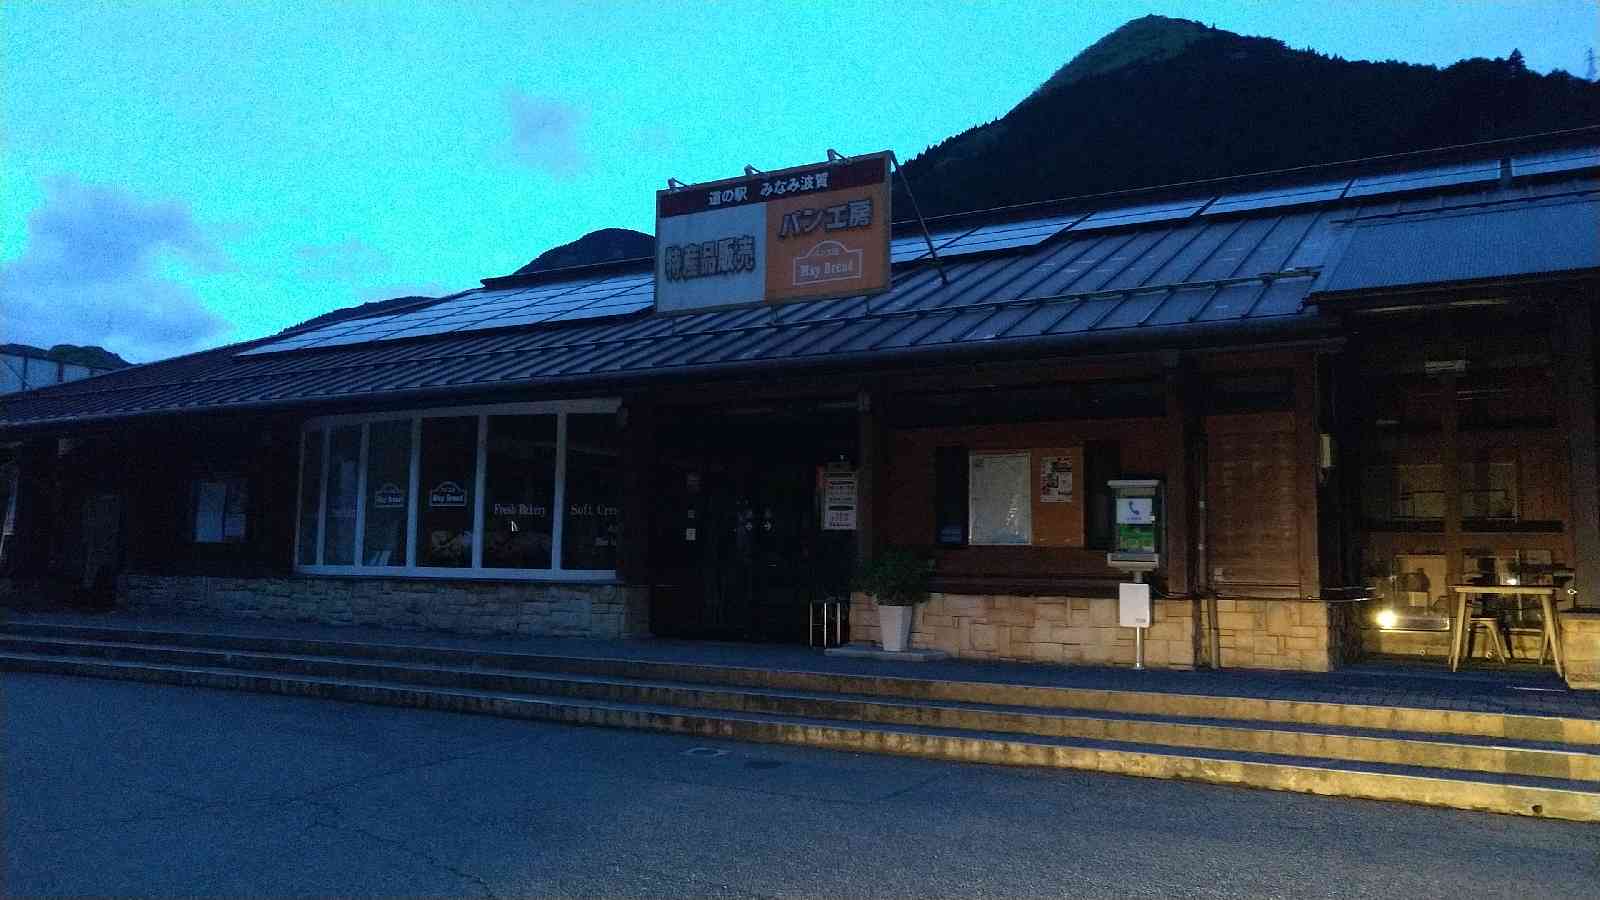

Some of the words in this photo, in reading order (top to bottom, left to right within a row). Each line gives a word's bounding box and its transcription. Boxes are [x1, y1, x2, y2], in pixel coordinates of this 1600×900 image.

[708, 187, 748, 206] 道の駅
[759, 172, 830, 197] みなみ波賀
[778, 200, 872, 240] パン工房
[664, 235, 756, 282] 特産品販売
[570, 503, 592, 515] Soft
